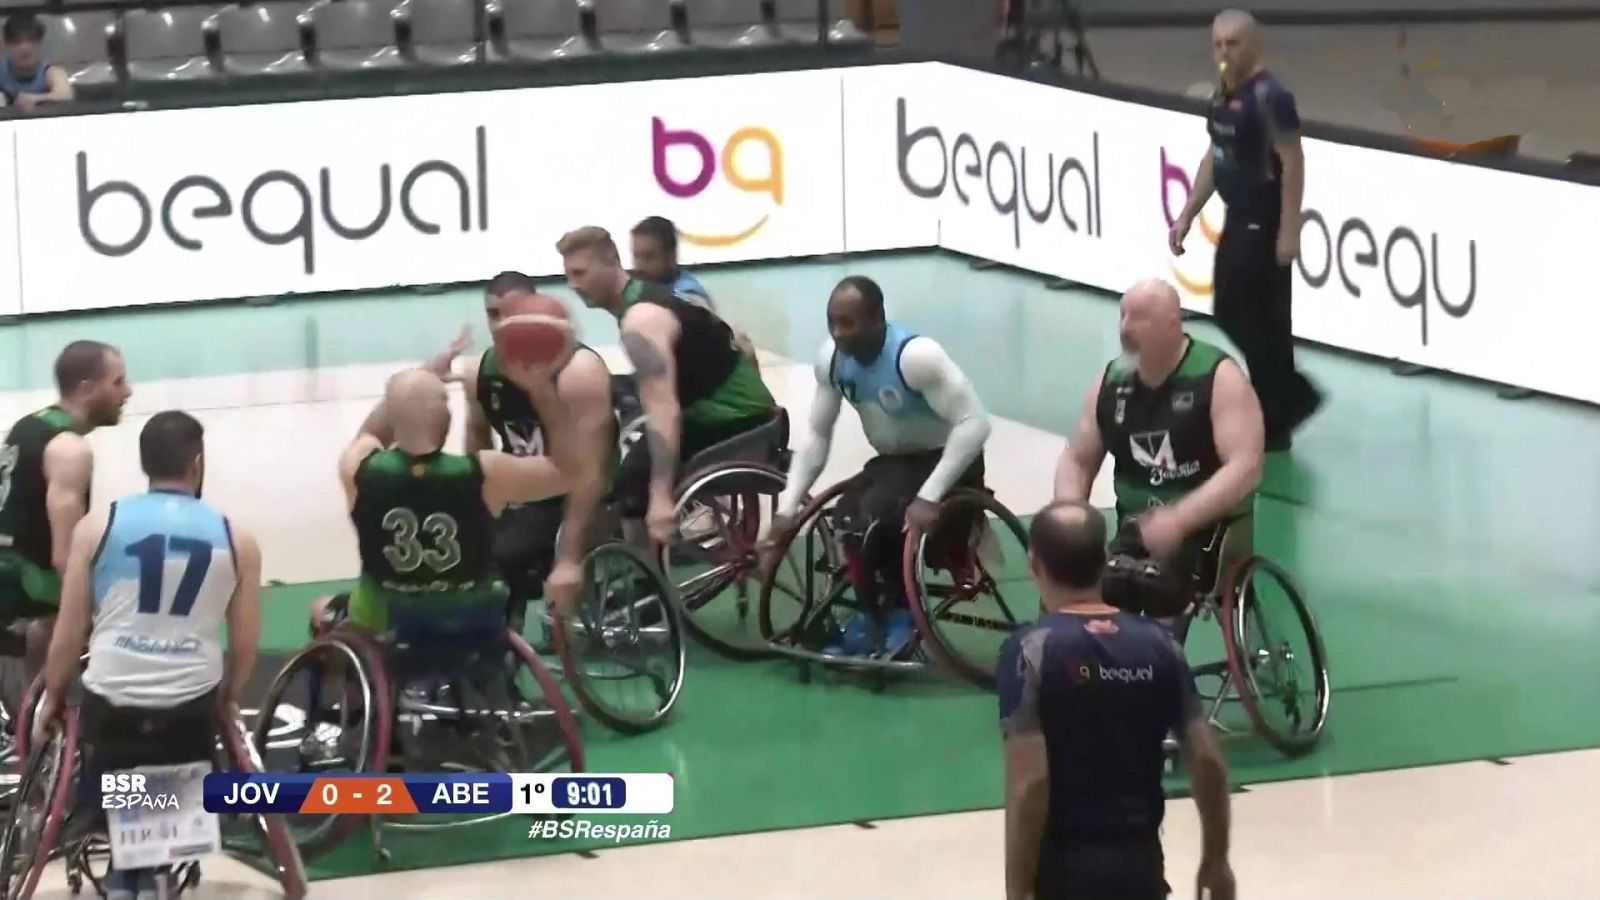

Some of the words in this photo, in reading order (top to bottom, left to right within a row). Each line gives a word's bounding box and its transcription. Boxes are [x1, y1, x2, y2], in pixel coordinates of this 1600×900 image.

[77, 125, 489, 274] bequal
[896, 97, 1101, 249] bequal
[125, 533, 213, 615] 17
[382, 507, 461, 572] 33
[1099, 664, 1153, 683] bequal
